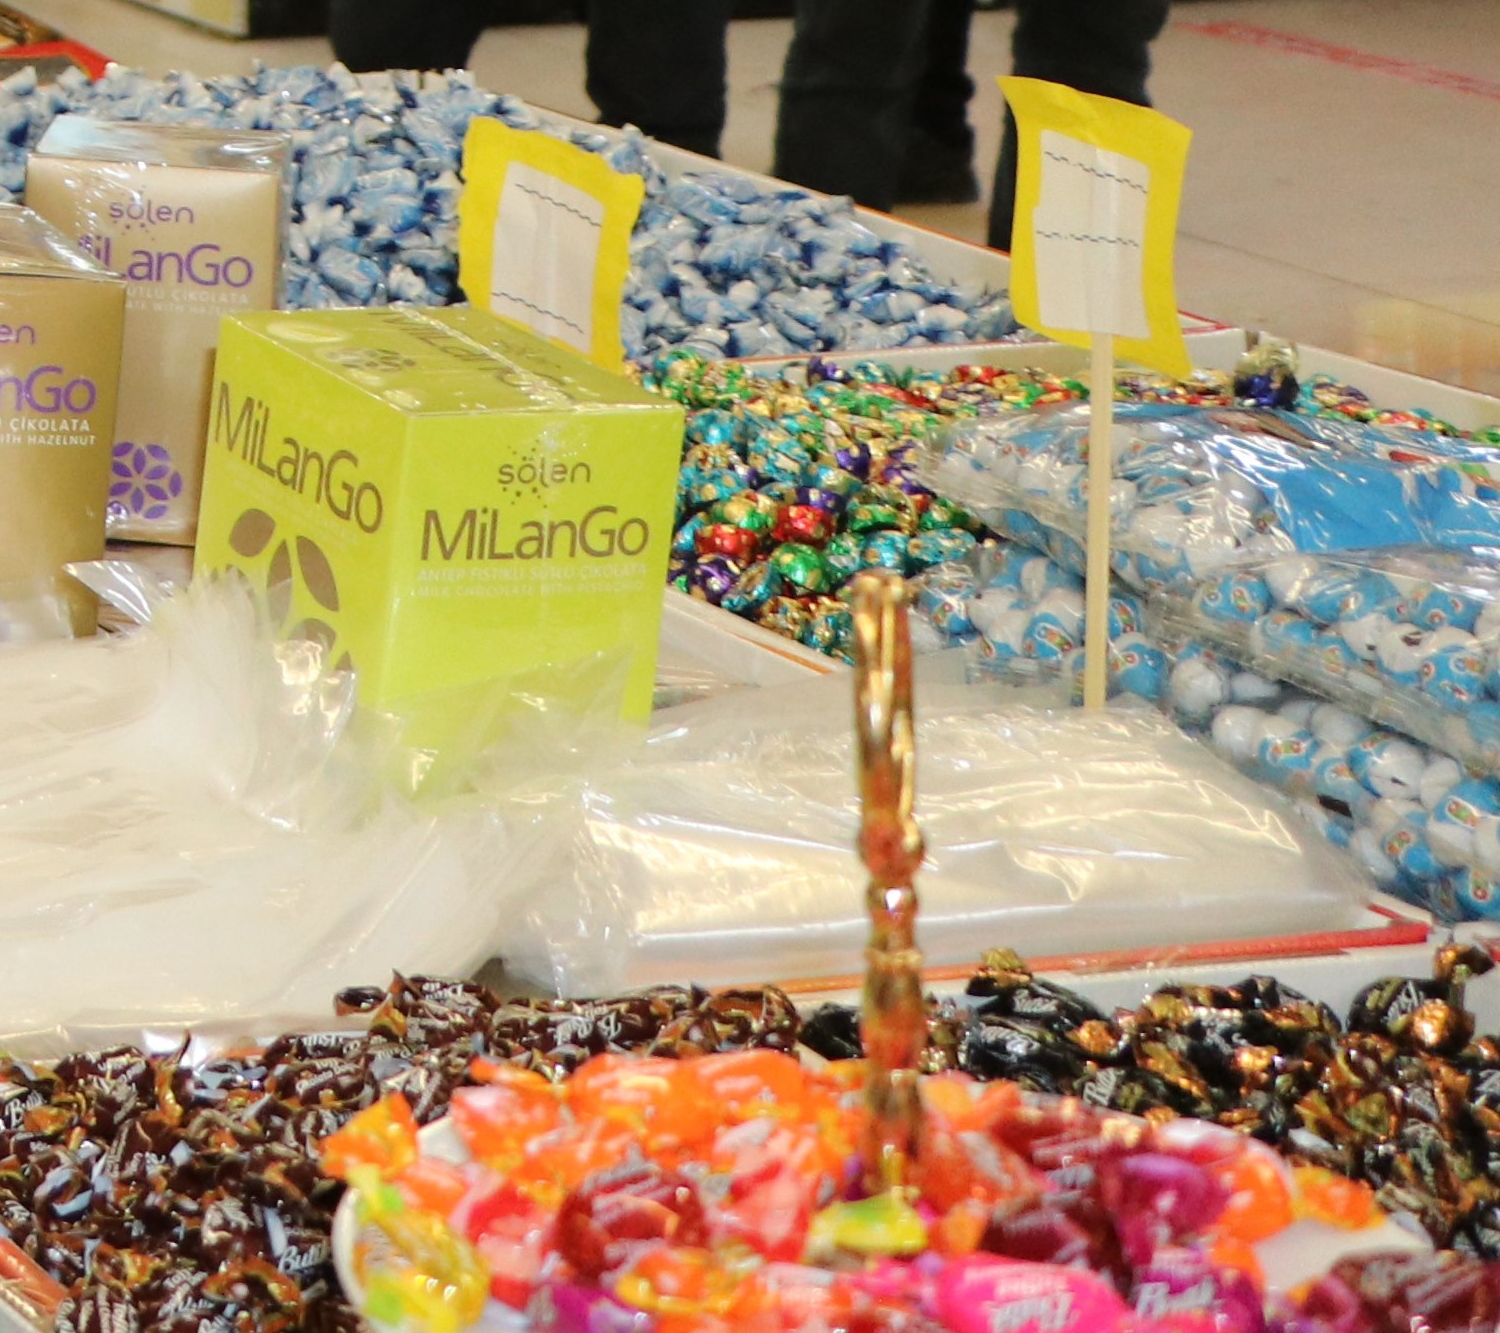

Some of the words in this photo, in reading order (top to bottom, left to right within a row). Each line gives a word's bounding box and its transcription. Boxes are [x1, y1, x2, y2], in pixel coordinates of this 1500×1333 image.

[10, 416, 90, 433] ÇİKOLATA
[216, 382, 383, 533] MiLanGo
[421, 506, 649, 562] MiLanGo
